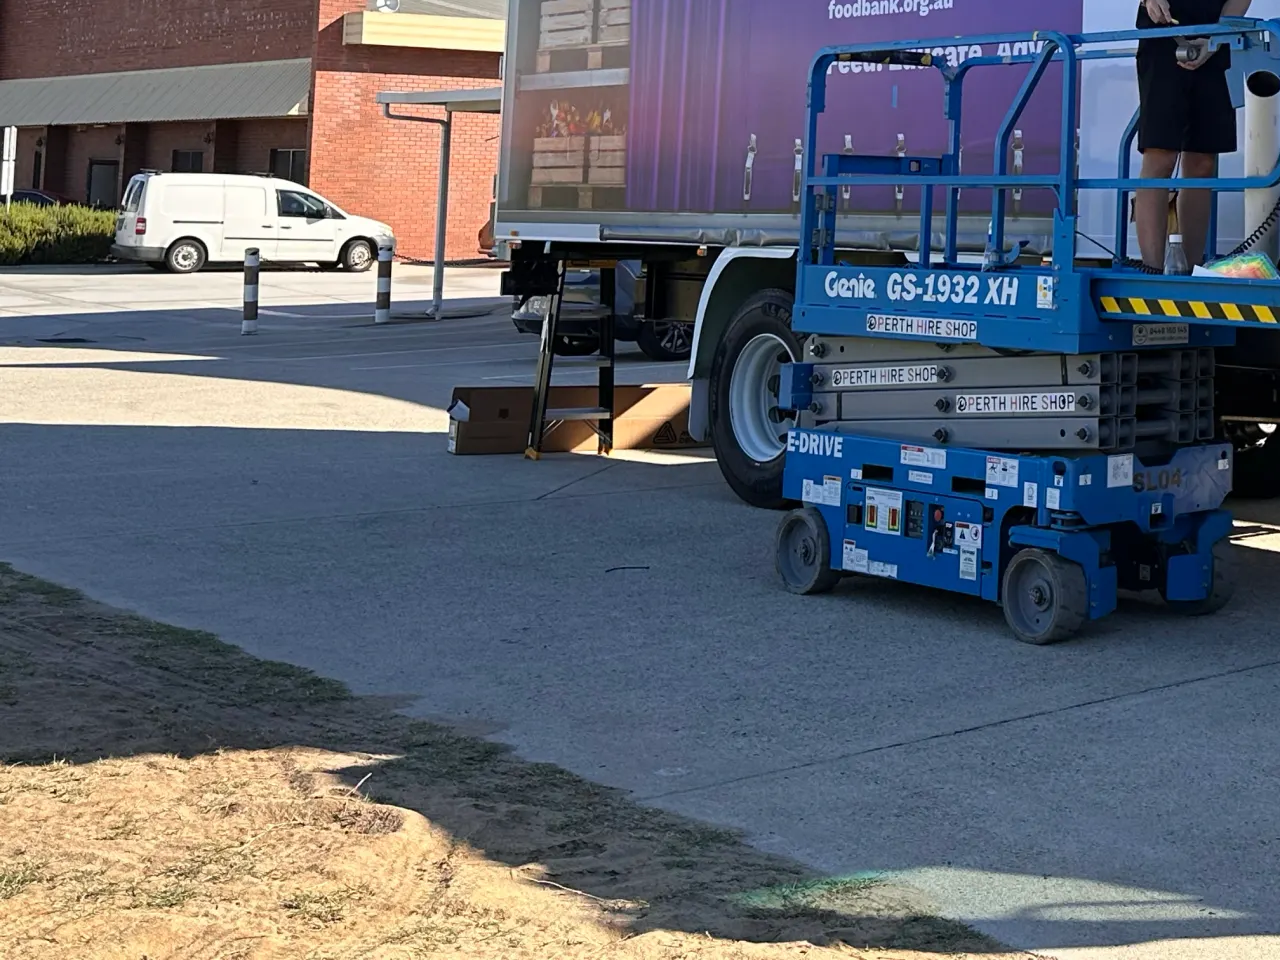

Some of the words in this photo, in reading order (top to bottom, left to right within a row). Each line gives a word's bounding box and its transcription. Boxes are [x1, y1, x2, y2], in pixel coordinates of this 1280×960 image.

[824, 271, 876, 299] Genie
[886, 272, 980, 304] GS-1932
[983, 276, 1019, 306] XH
[877, 316, 913, 333] PERTH
[916, 319, 942, 335] HIRE
[945, 321, 977, 338] SHOP
[843, 369, 877, 385] PERTH
[880, 368, 905, 384] HIRE
[907, 366, 937, 382] SHOP
[968, 396, 1006, 411] PERTH
[1010, 395, 1038, 411] HIRE
[1041, 394, 1075, 410] SHOP
[787, 431, 844, 458] E-DRIVE
